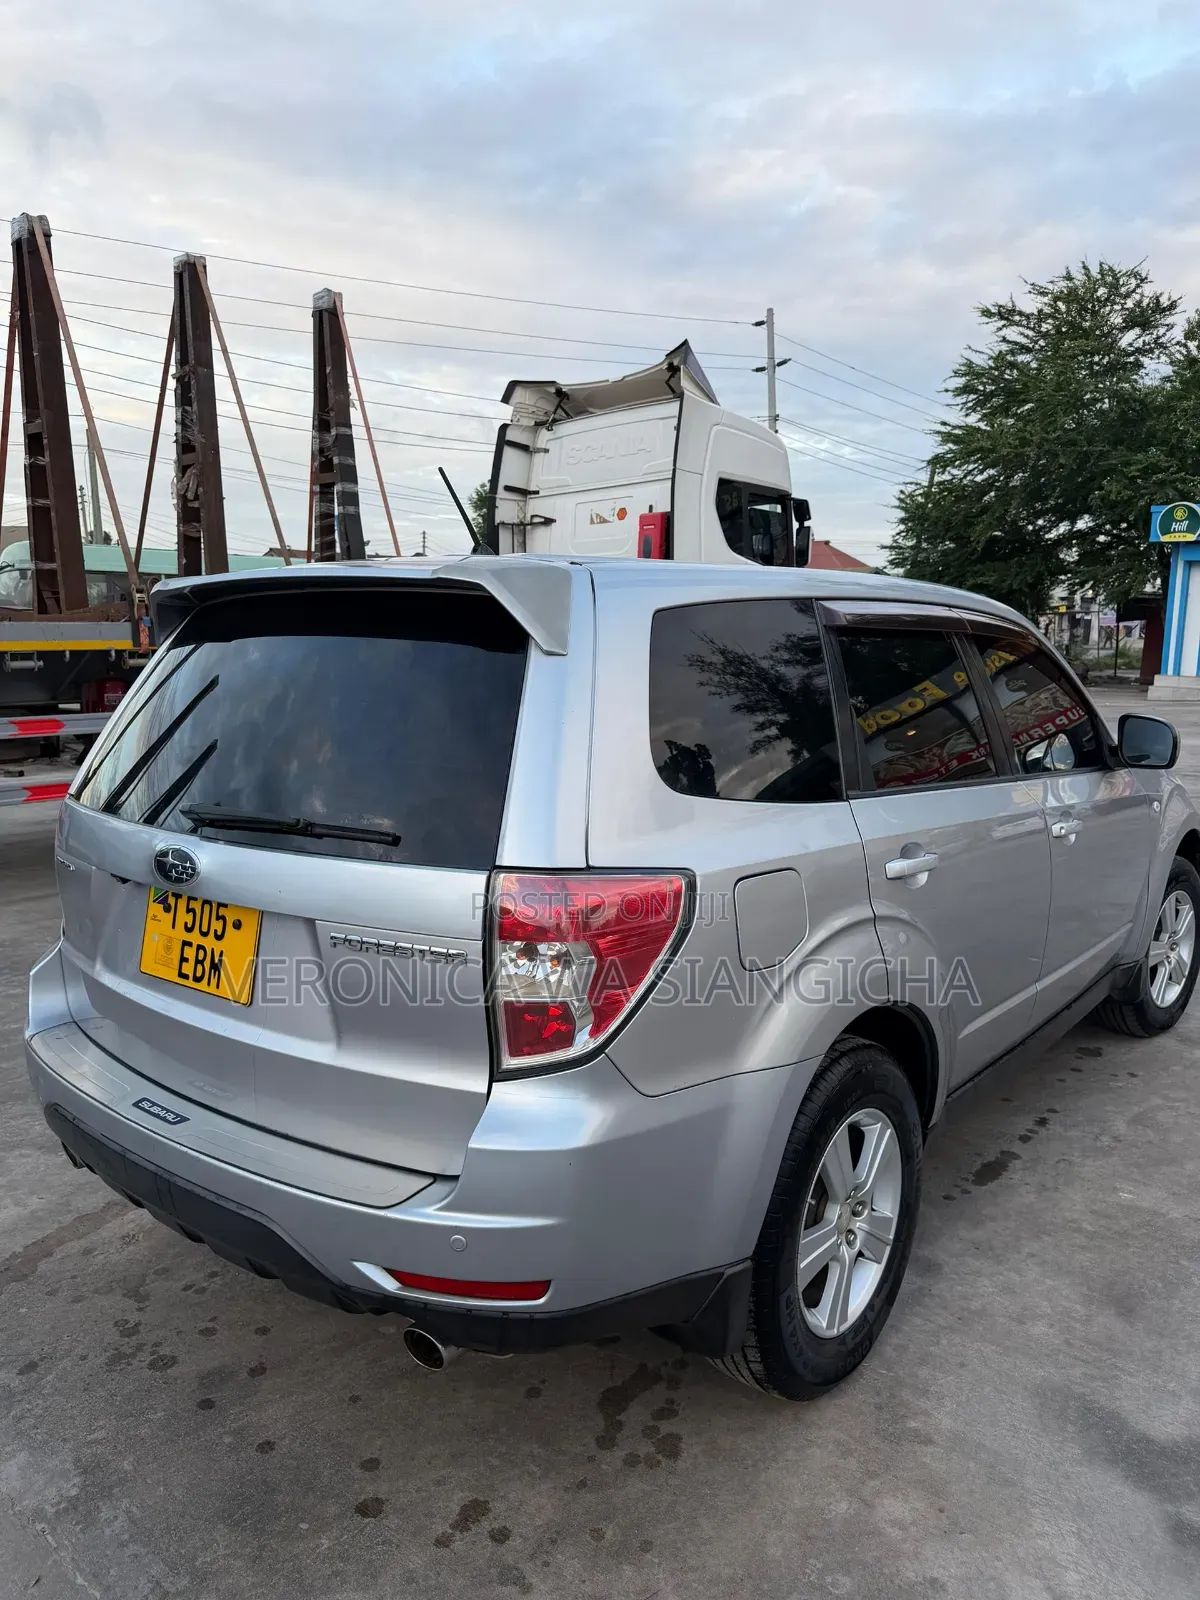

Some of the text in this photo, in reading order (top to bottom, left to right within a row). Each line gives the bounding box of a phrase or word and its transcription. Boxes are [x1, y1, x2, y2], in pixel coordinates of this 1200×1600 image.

[1171, 520, 1189, 532] Hill
[171, 891, 229, 942] T505
[177, 939, 225, 990] EBM
[330, 932, 468, 967] FORESTER
[138, 1100, 181, 1122] SUBARU
